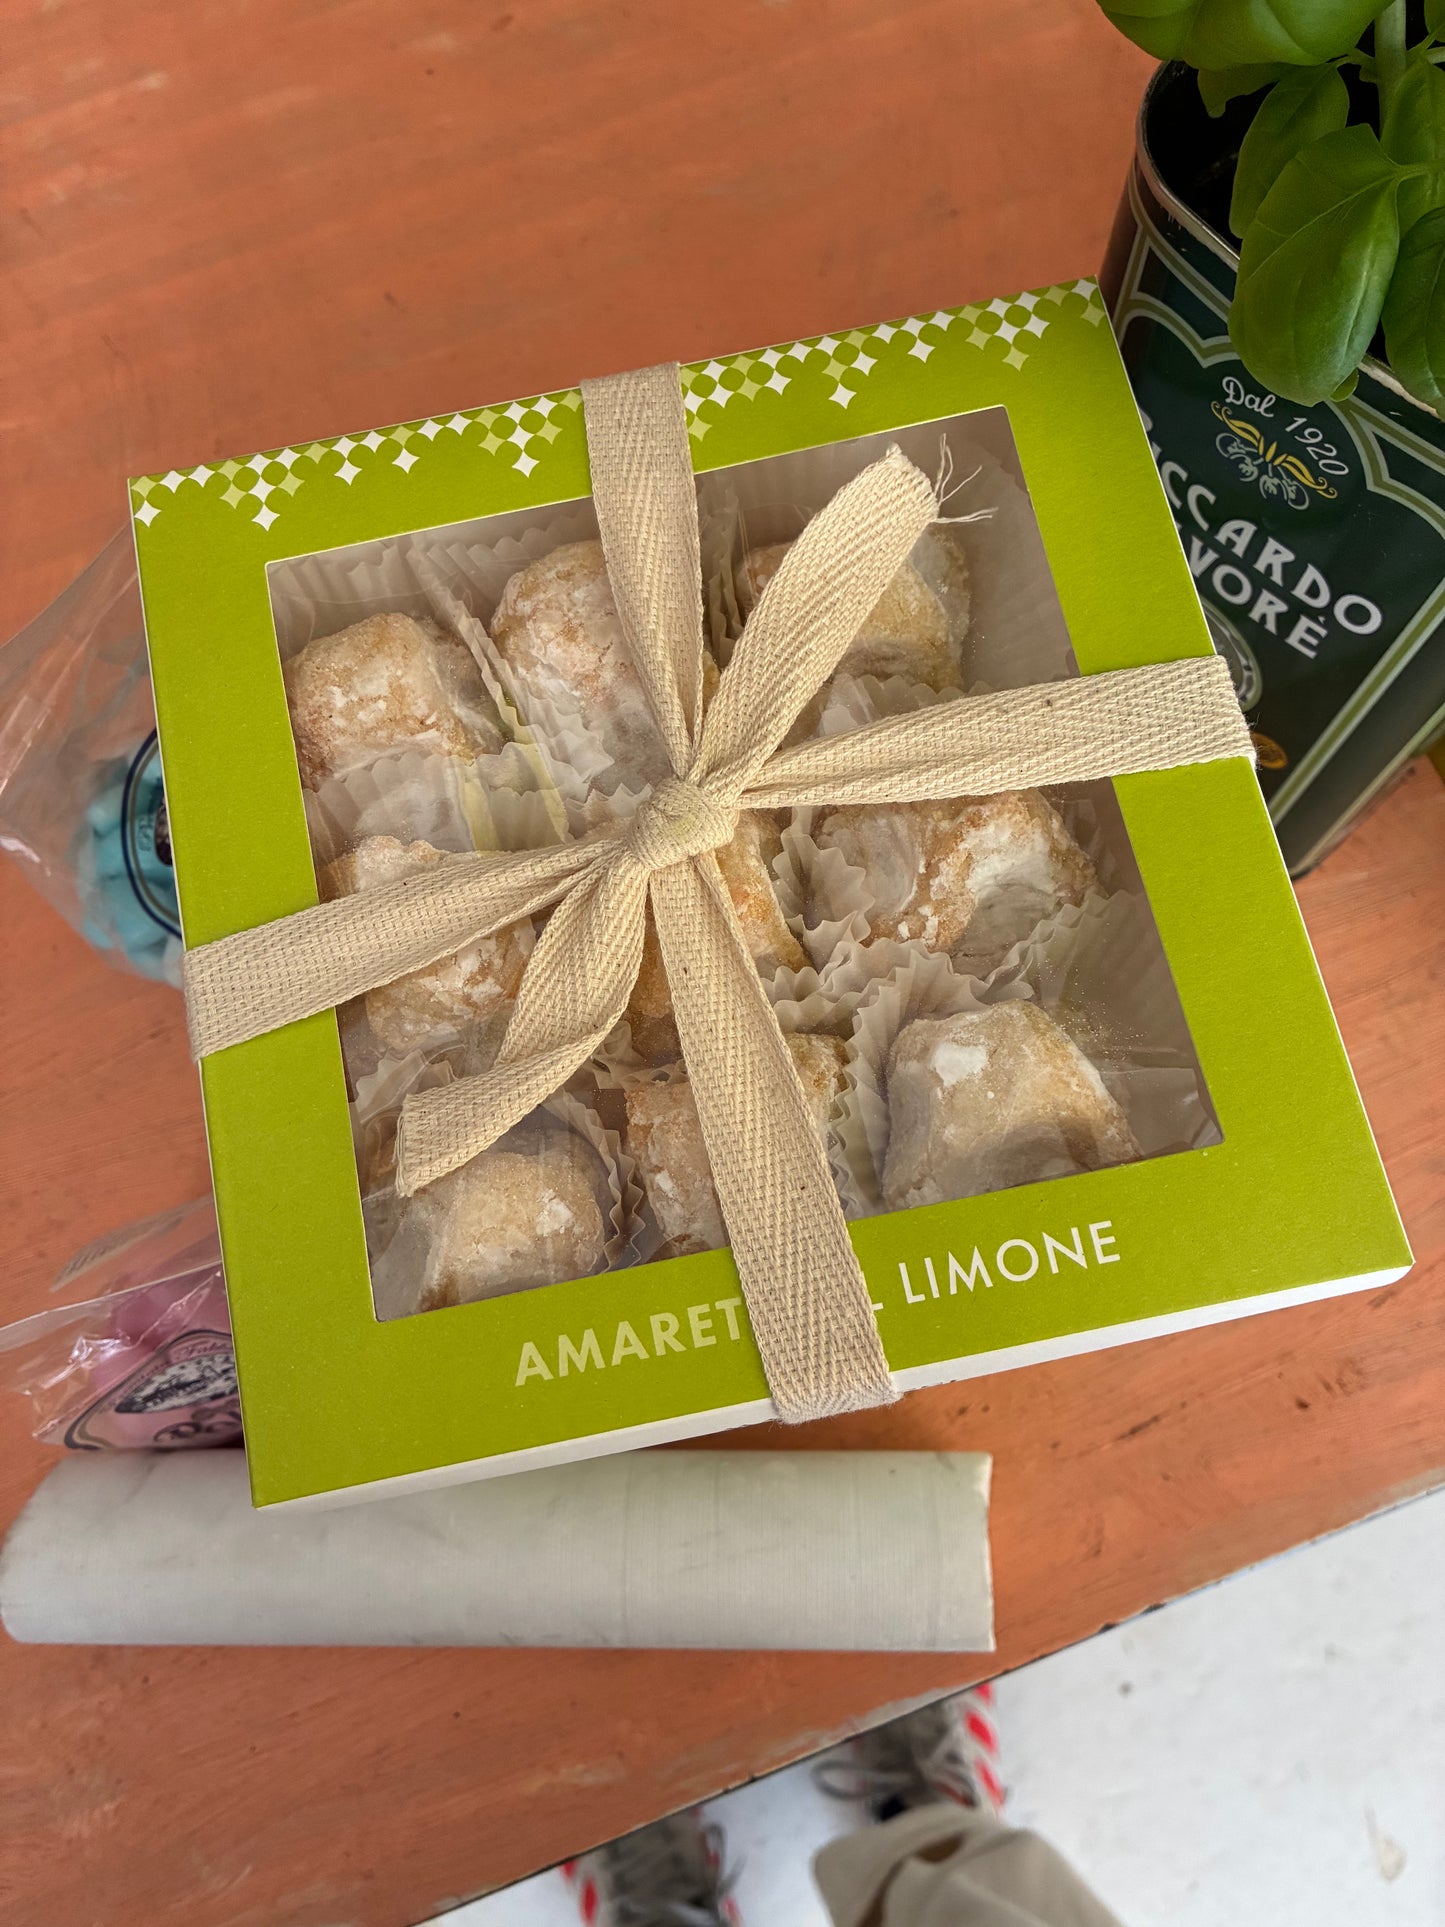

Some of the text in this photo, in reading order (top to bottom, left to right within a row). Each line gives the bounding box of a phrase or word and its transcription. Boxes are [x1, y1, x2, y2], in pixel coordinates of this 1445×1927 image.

[1221, 376, 1350, 477] Dal 1920
[1140, 406, 1382, 636] CCARDO
[514, 1220, 1121, 1386] AMARET LIMONE
